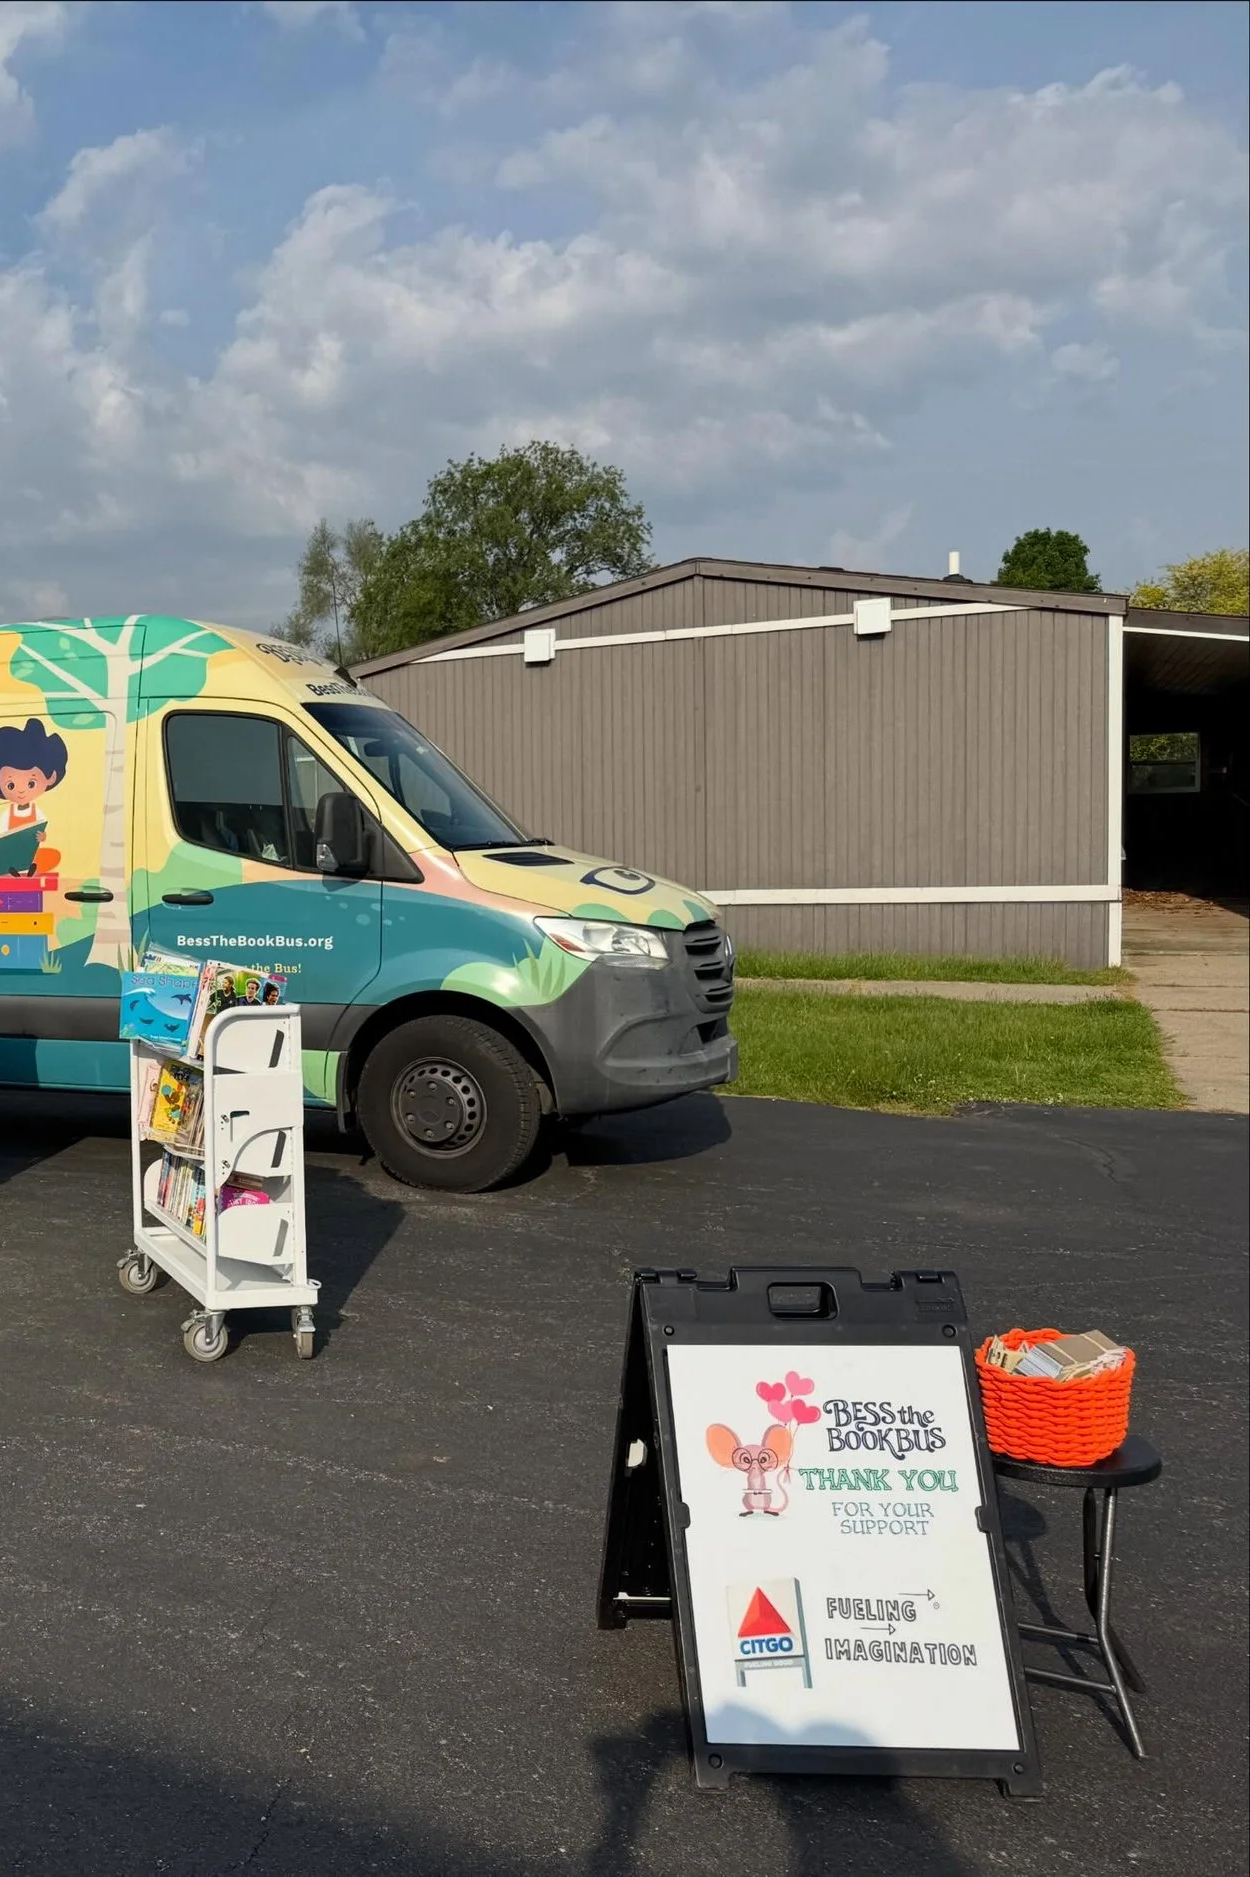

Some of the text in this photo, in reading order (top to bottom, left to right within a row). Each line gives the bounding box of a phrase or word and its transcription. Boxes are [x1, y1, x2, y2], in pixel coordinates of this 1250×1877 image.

[177, 934, 334, 950] BessTheBookBus.org
[251, 962, 302, 973] the Bus!
[822, 1399, 935, 1432] BESS the
[799, 1468, 959, 1493] THANK YOU
[832, 1502, 935, 1518] FOR YOUR
[840, 1519, 930, 1535] SUPPORT
[826, 1597, 917, 1622] FUELING
[739, 1636, 794, 1655] CITGO
[824, 1638, 978, 1666] IMAGINATION
